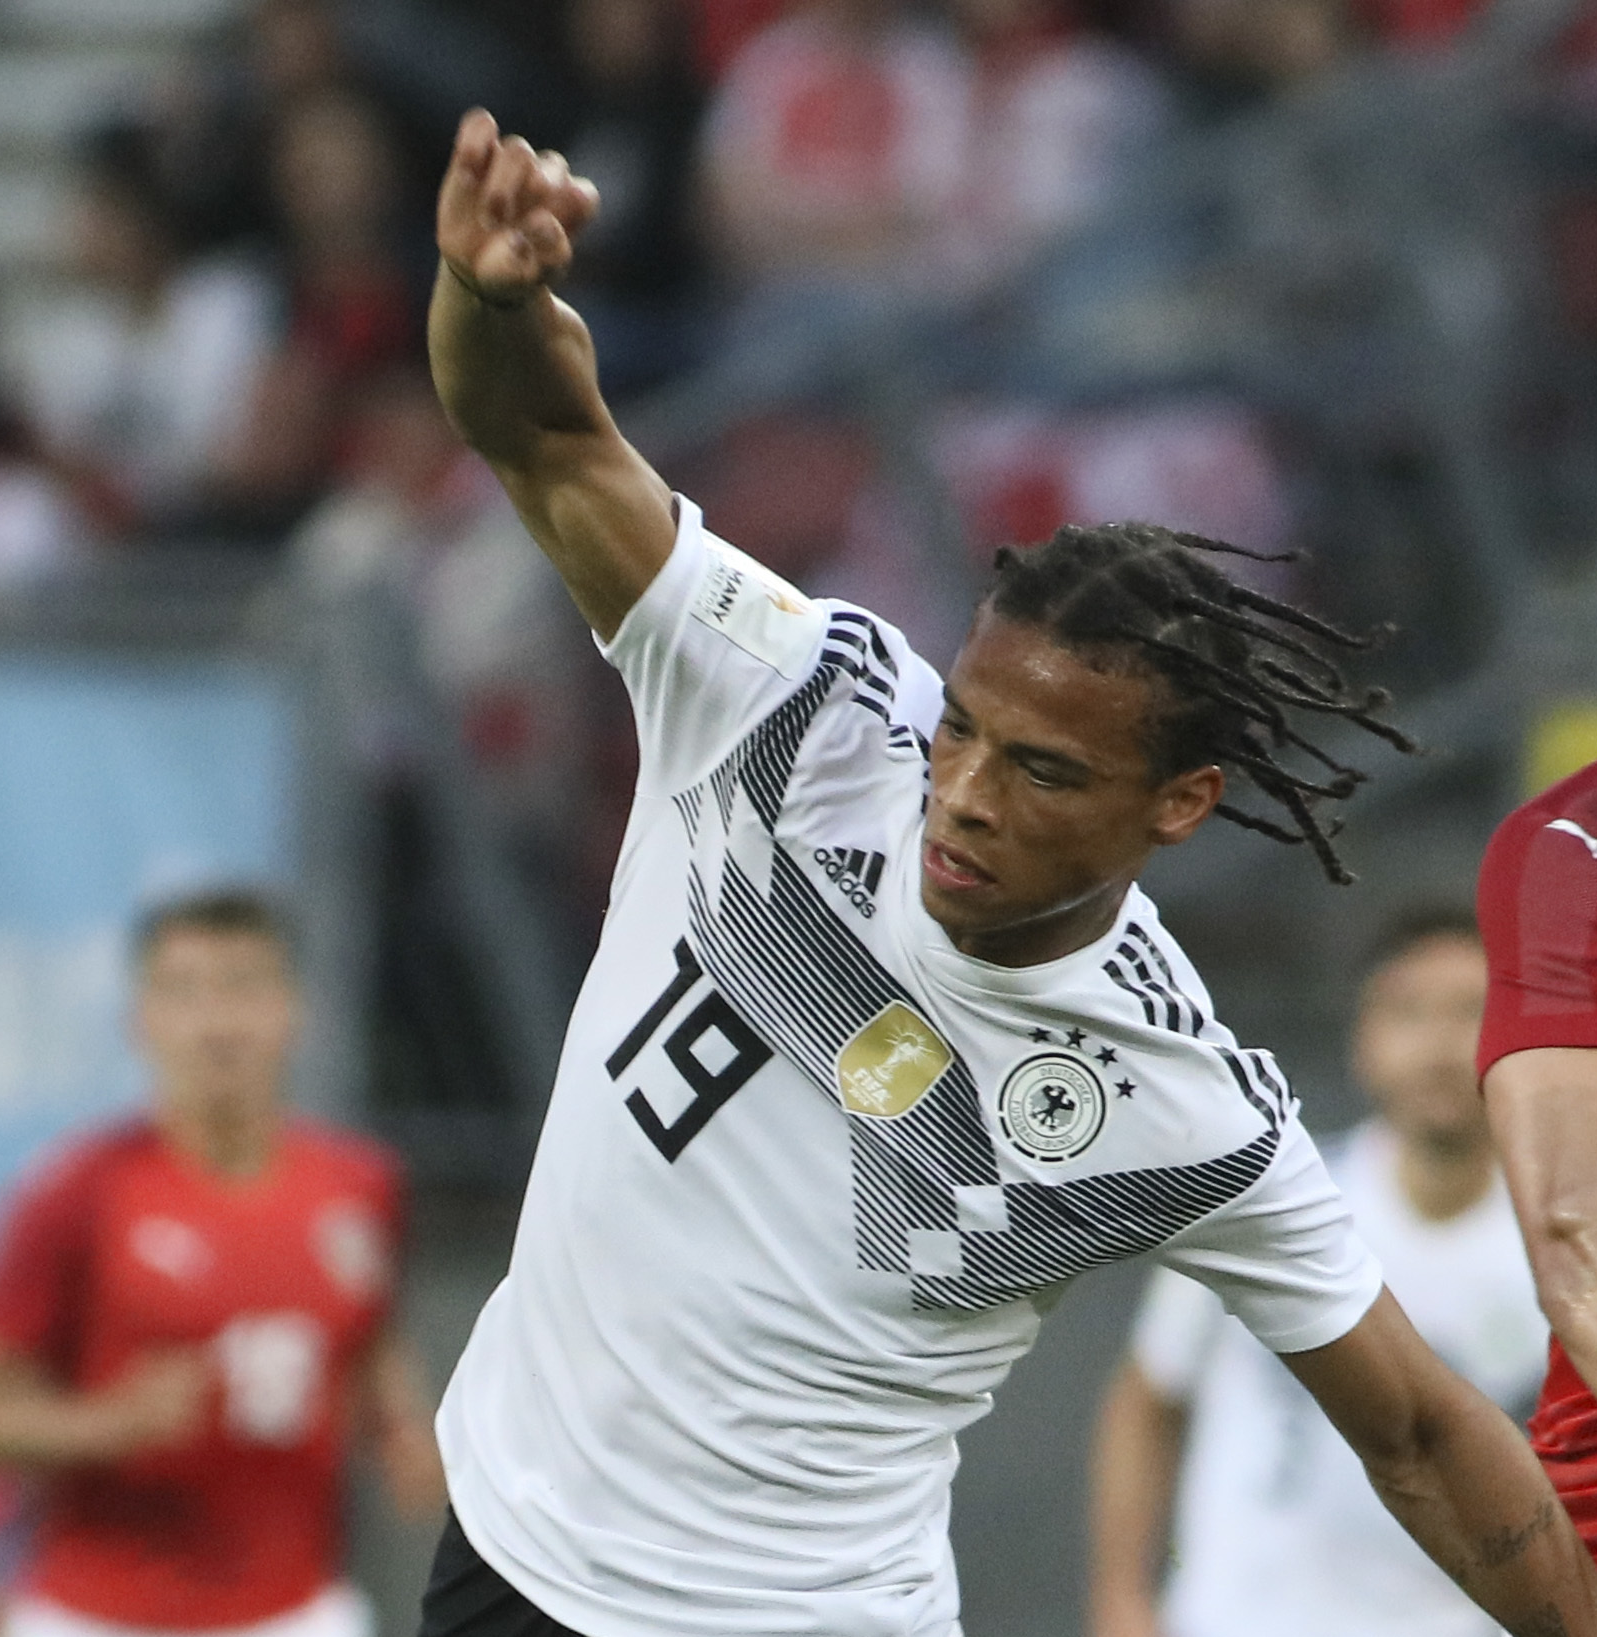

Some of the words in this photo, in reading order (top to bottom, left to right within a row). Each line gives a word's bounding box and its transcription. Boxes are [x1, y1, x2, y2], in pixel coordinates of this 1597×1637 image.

[814, 848, 878, 919] adidas
[604, 934, 776, 1165] 19
[853, 1067, 893, 1104] FIFA
